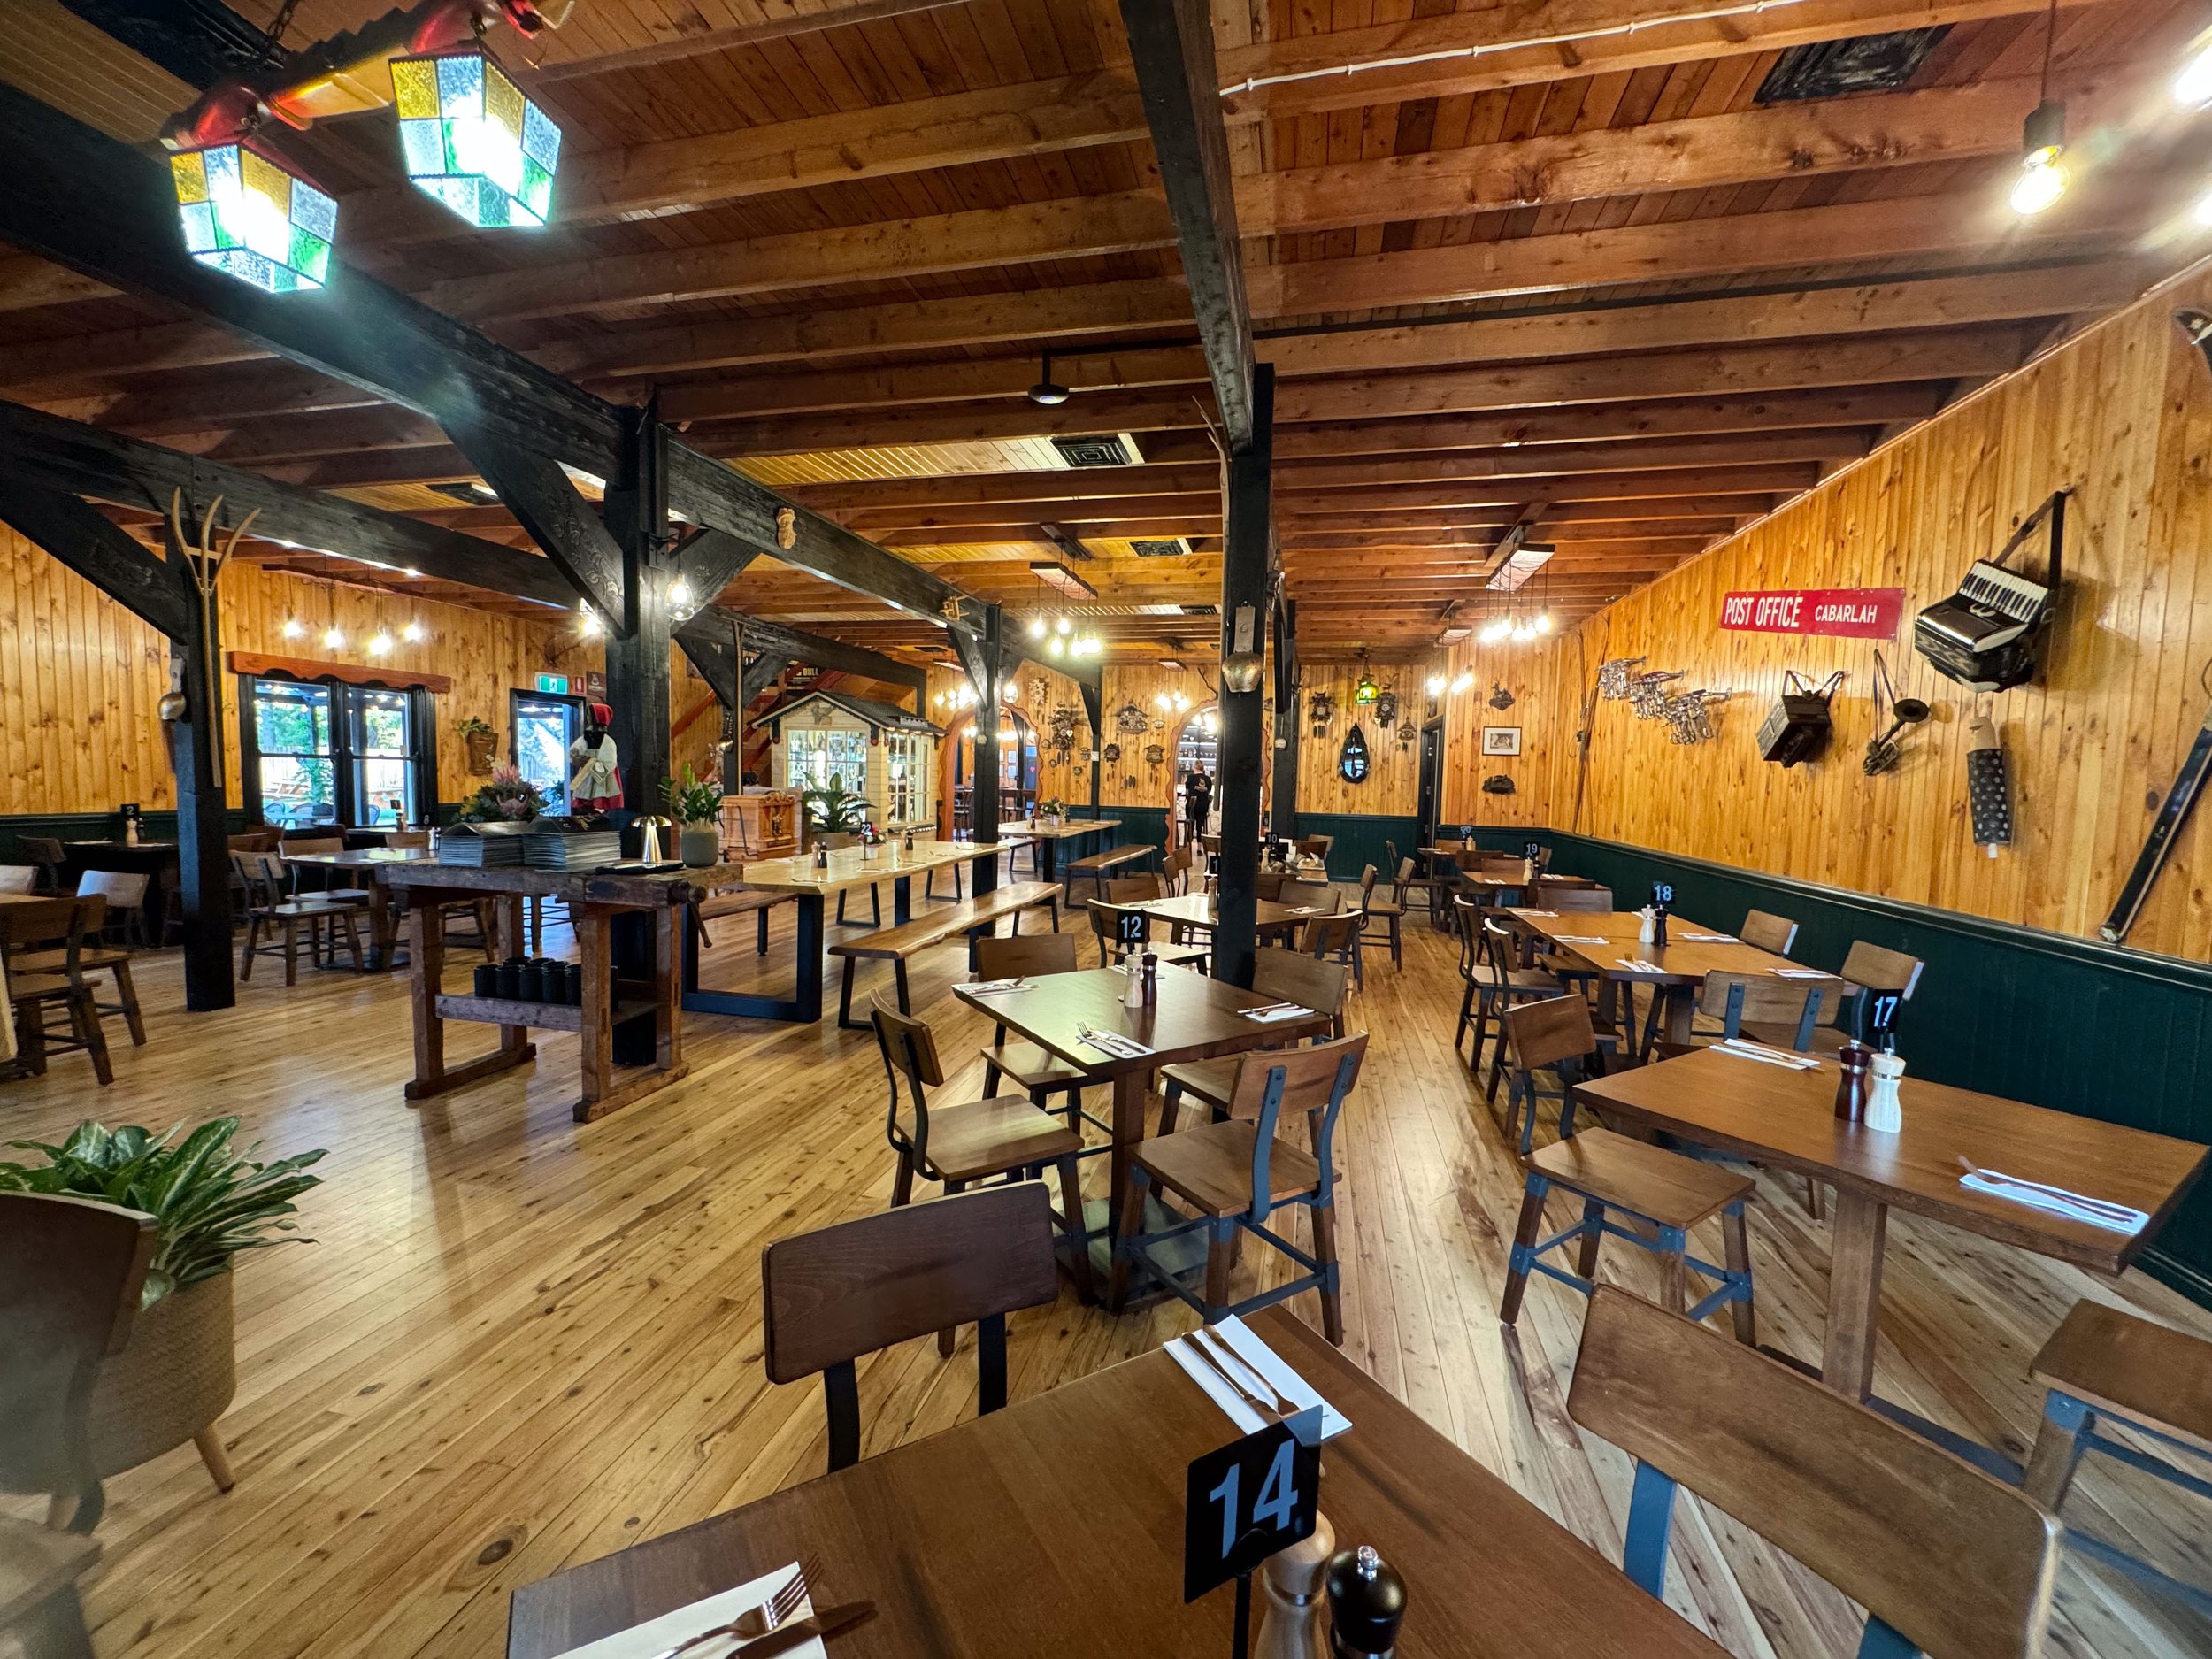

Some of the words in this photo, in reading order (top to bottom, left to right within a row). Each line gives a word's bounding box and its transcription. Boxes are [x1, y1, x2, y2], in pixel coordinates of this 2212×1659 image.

[1724, 597, 1754, 625] POST
[1755, 596, 1803, 627] OFFICE
[1815, 604, 1878, 623] CABARLAH
[127, 806, 134, 815] 2
[424, 814, 430, 825] 8
[861, 823, 871, 833] 22
[1267, 833, 1278, 844] 10
[1525, 843, 1538, 856] 19
[1654, 885, 1672, 901] 18
[1120, 915, 1141, 939] 12
[1873, 996, 1898, 1027] 17
[1210, 1438, 1299, 1559] 14
